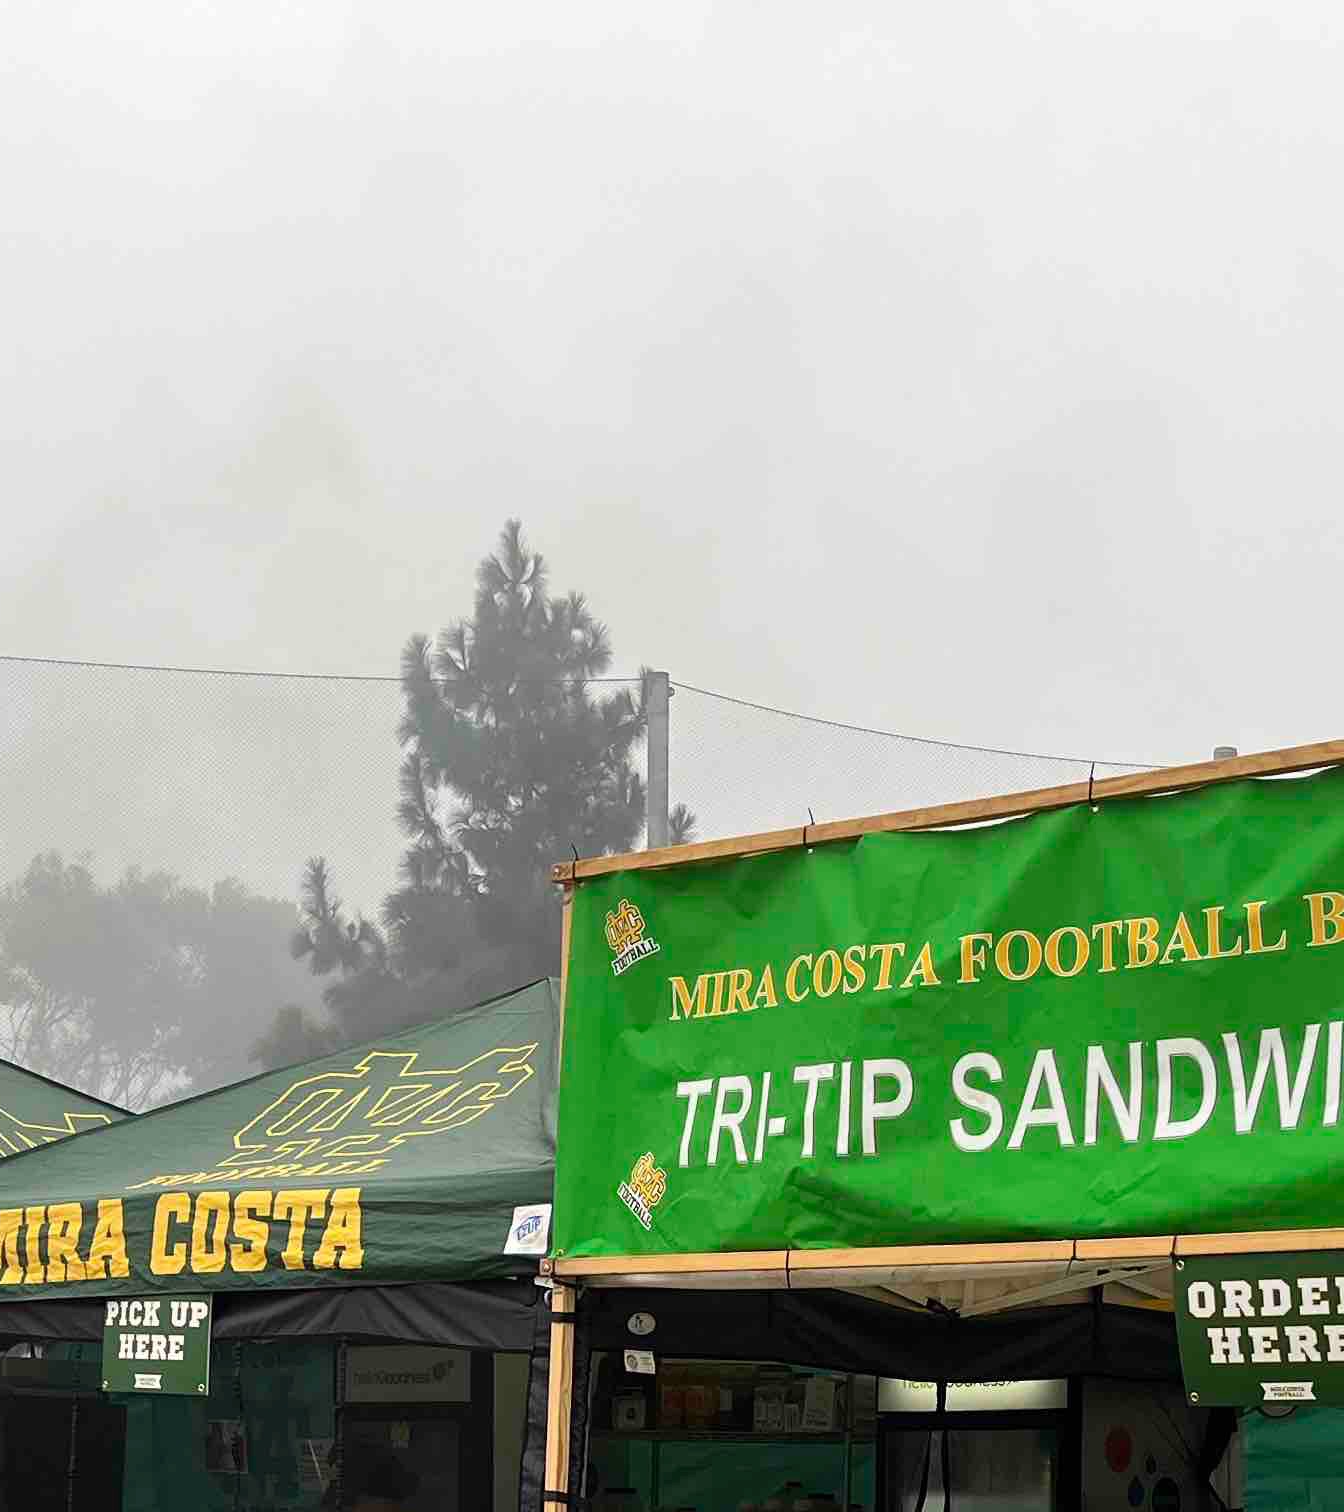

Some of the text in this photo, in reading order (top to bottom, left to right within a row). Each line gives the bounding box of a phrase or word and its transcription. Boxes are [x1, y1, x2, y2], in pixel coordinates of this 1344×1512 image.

[613, 940, 659, 974] FOOTBALL
[668, 964, 777, 1021] MIRA
[784, 941, 941, 1003] COSTA
[957, 900, 1287, 984] FOOTBALL
[676, 1057, 914, 1168] TRI-TIP
[150, 1187, 365, 1275] COSTA
[105, 1300, 208, 1328] PICK UP
[118, 1333, 184, 1360] HERE
